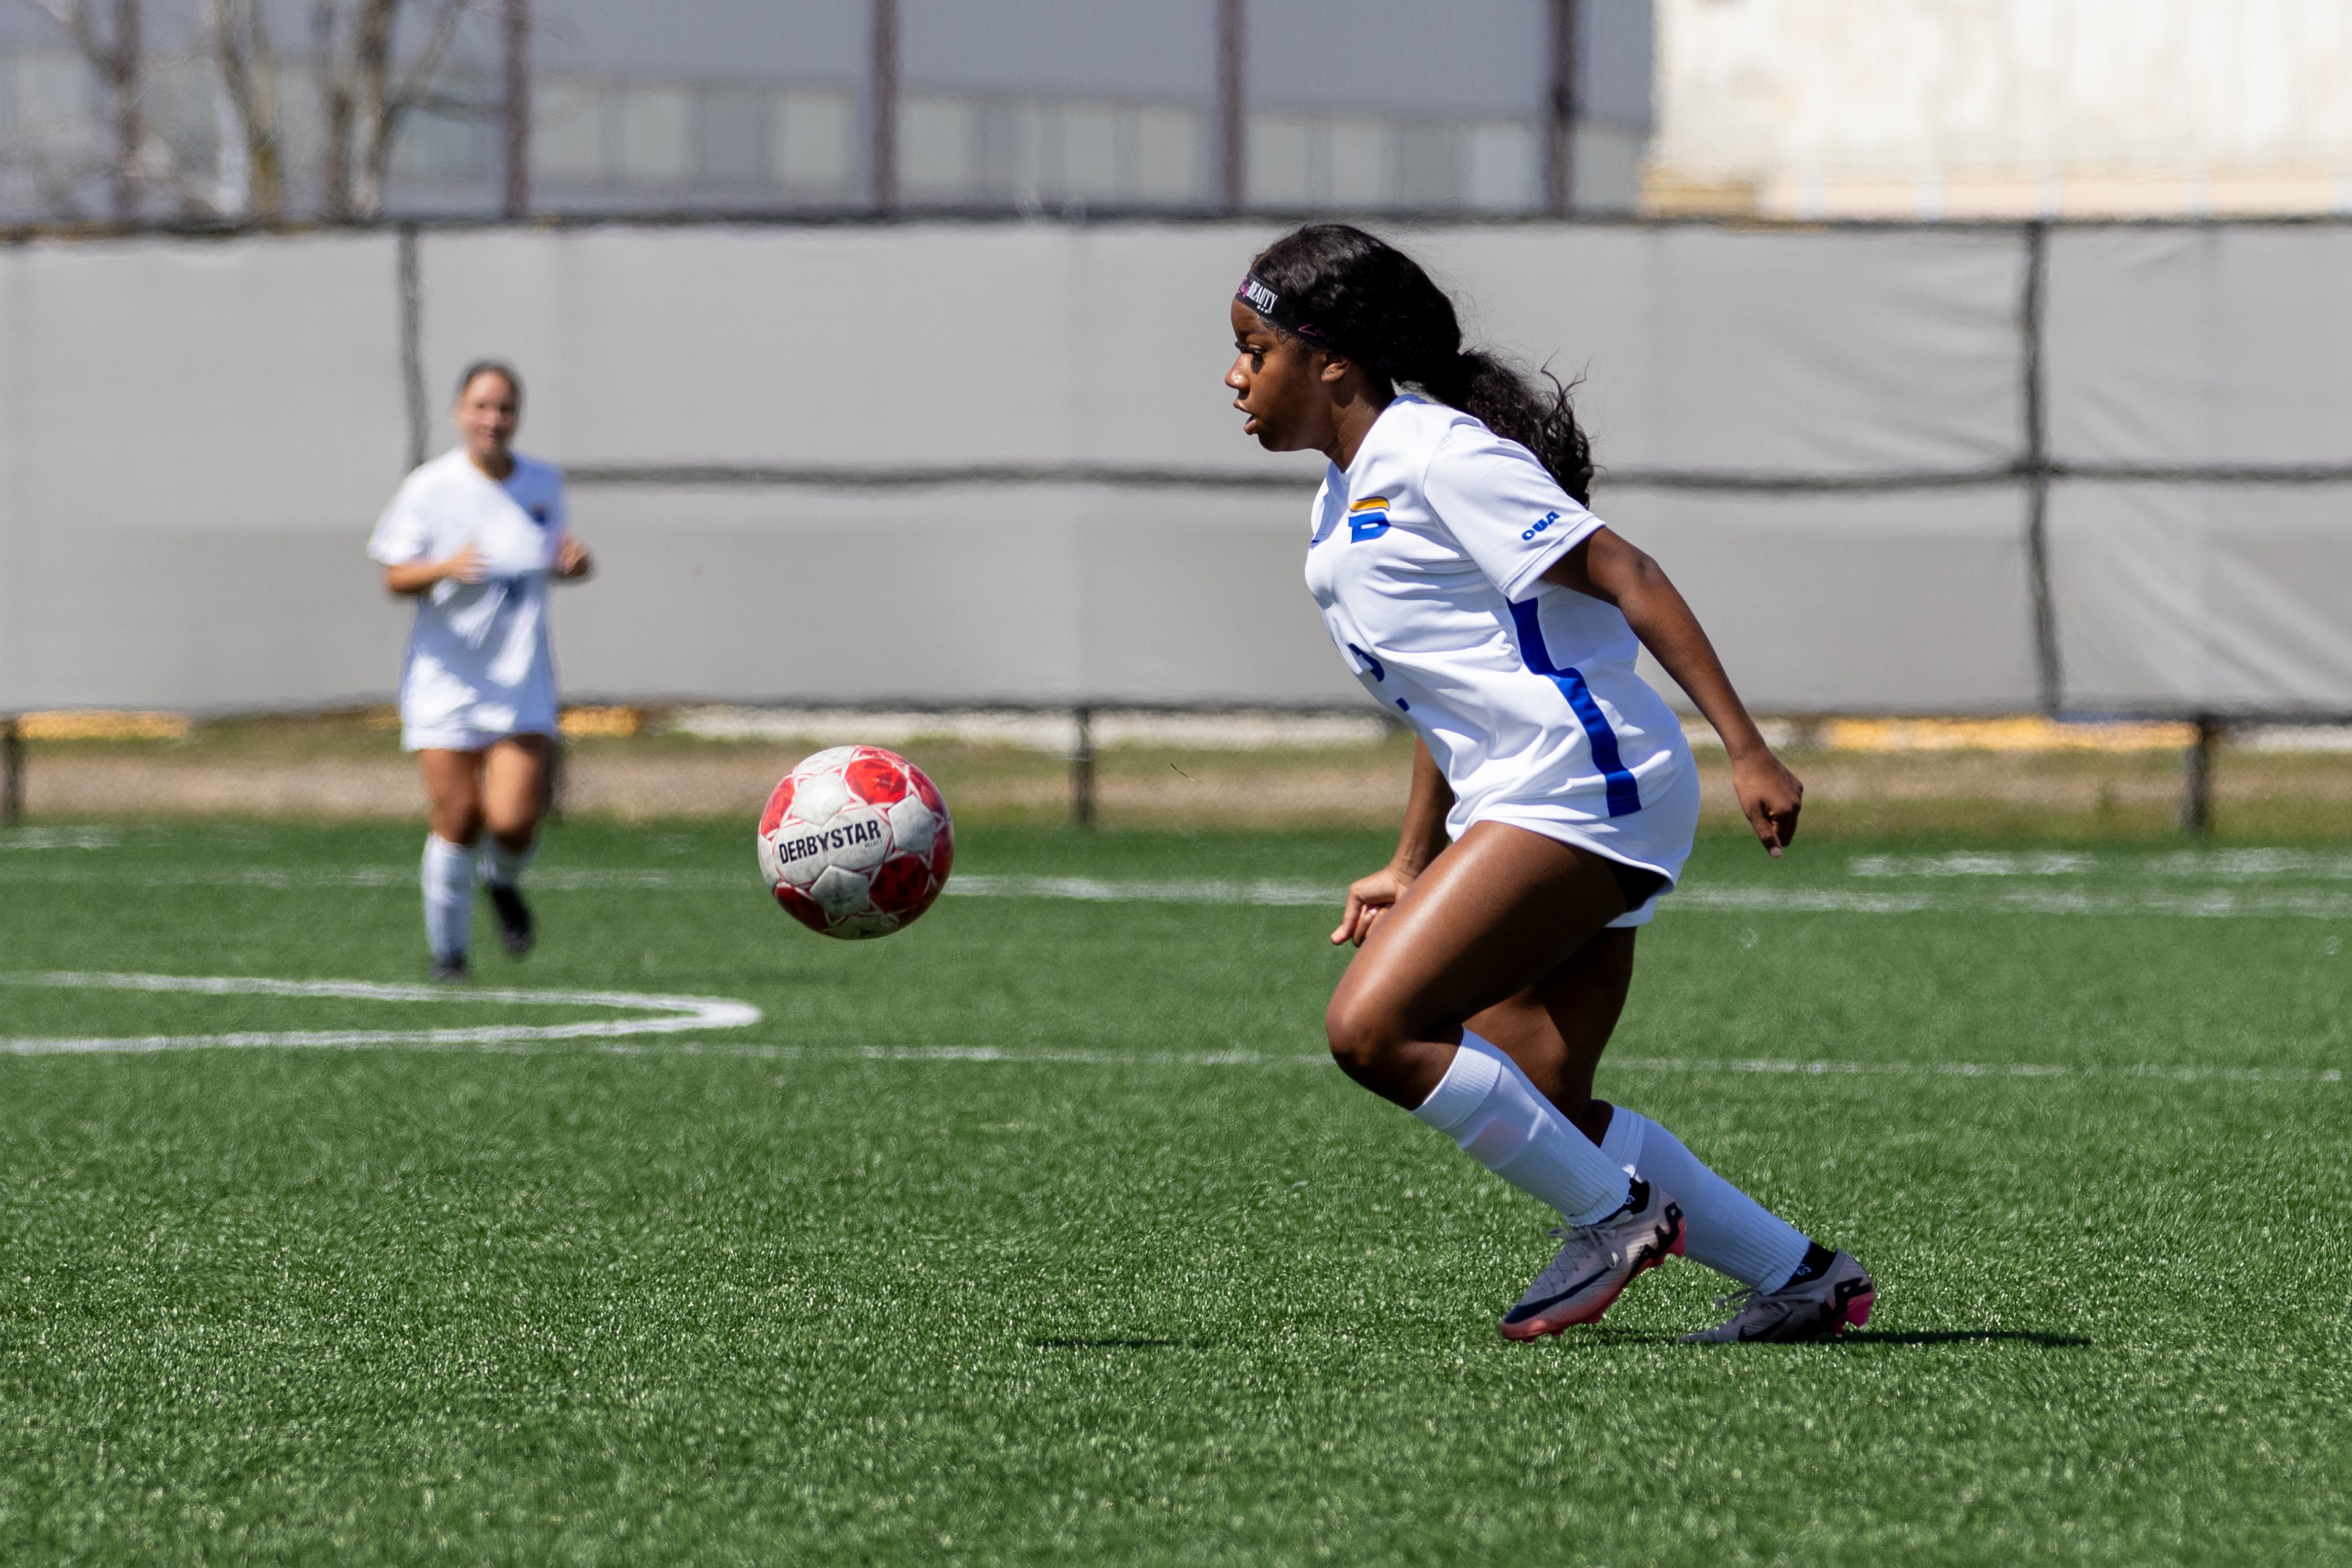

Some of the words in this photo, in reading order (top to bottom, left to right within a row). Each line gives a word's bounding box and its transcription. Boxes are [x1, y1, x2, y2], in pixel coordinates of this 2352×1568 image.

[1246, 280, 1278, 311] BEAUTY
[1521, 510, 1561, 541] OUA
[779, 820, 881, 864] DERBYSTAR
